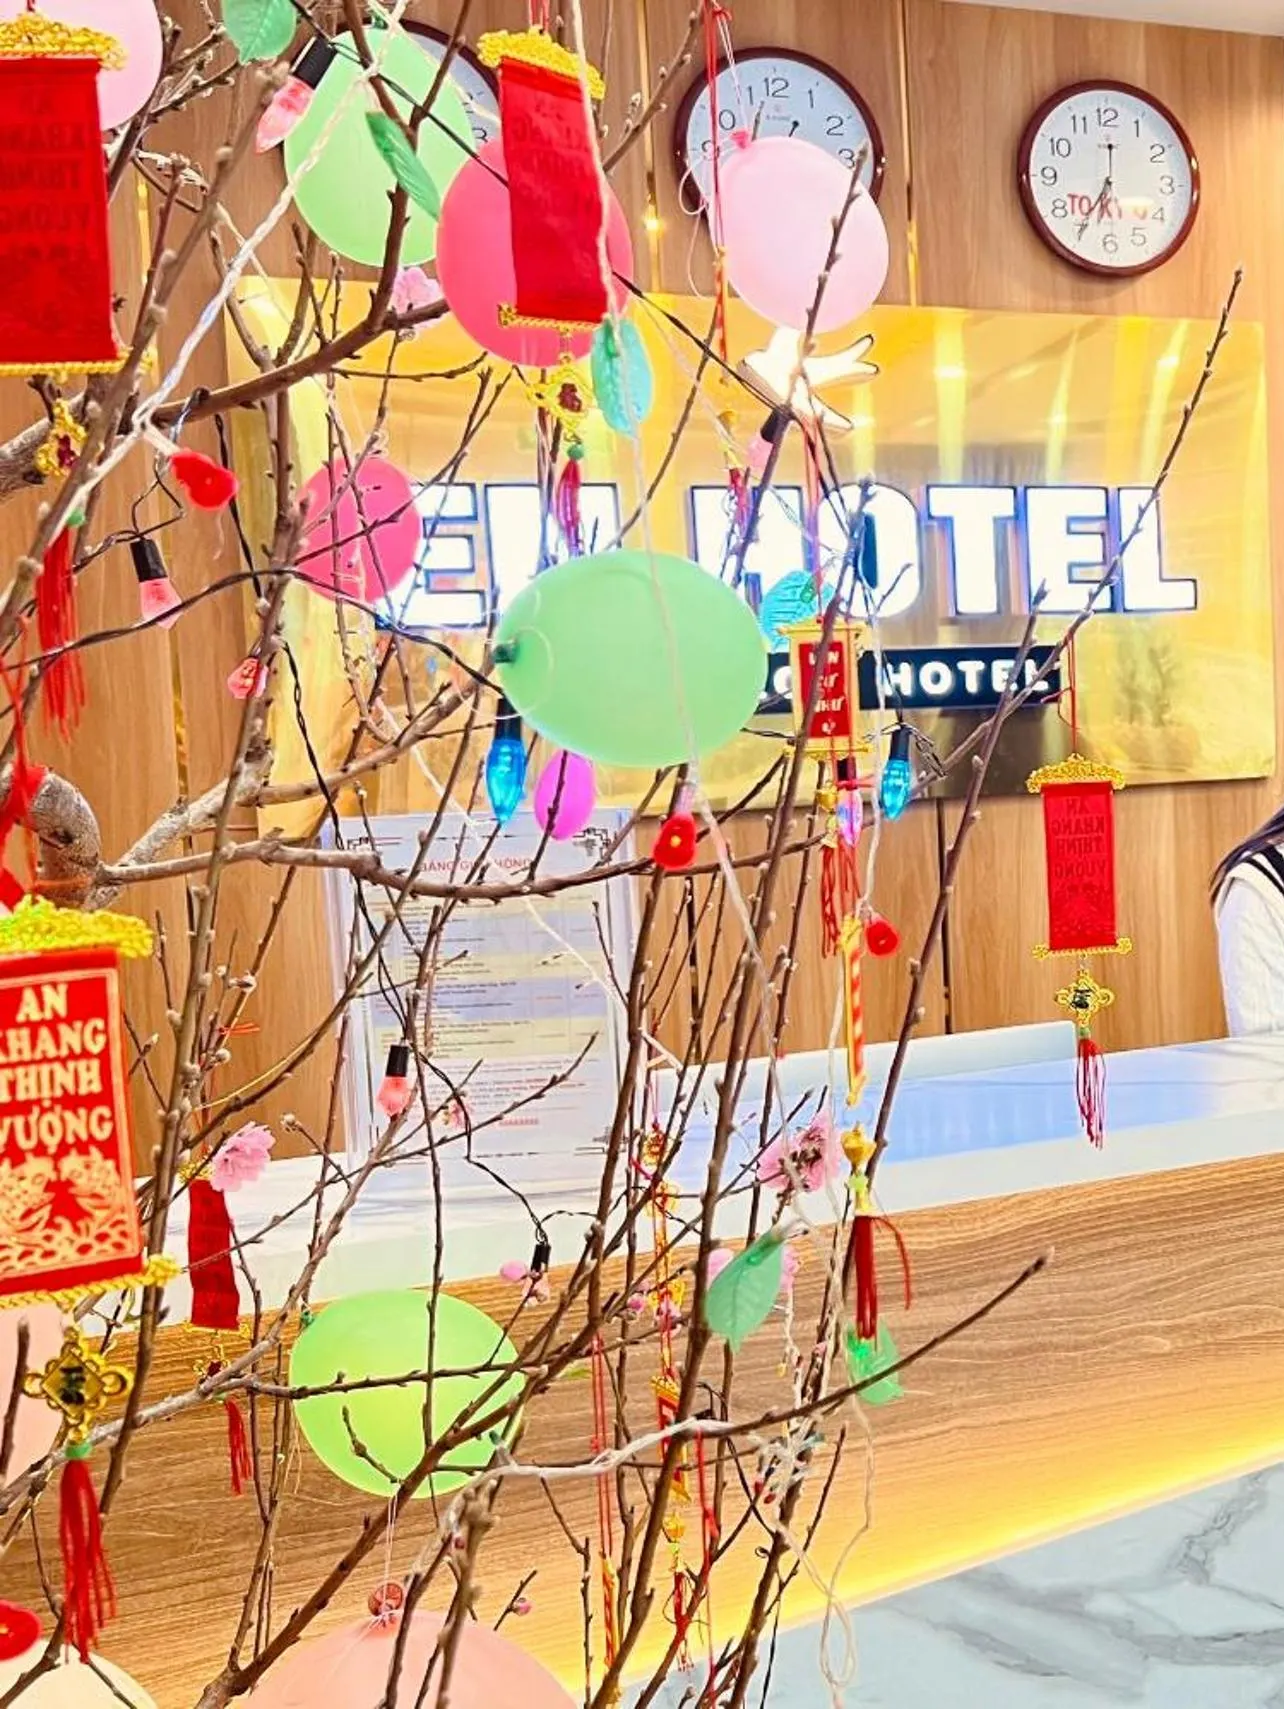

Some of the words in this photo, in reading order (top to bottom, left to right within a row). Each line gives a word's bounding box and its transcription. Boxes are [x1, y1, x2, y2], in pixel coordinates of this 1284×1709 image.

[764, 77, 789, 99] 12
[808, 88, 814, 108] 1
[826, 115, 844, 136] 2
[1071, 114, 1088, 134] 11
[1096, 108, 1119, 128] 12
[1134, 119, 1140, 138] 1
[1049, 137, 1071, 158] 10
[1150, 144, 1165, 163] 2
[1041, 166, 1057, 186] 9
[1160, 175, 1175, 196] 3
[1051, 198, 1068, 219] 8
[1152, 207, 1165, 224] 4
[1102, 234, 1118, 254] 6
[1130, 227, 1147, 247] 5
[689, 482, 1197, 618] HOTEL
[882, 658, 1049, 695] HOTEL
[16, 983, 68, 1023] AN
[0, 1058, 102, 1108] THỊNH
